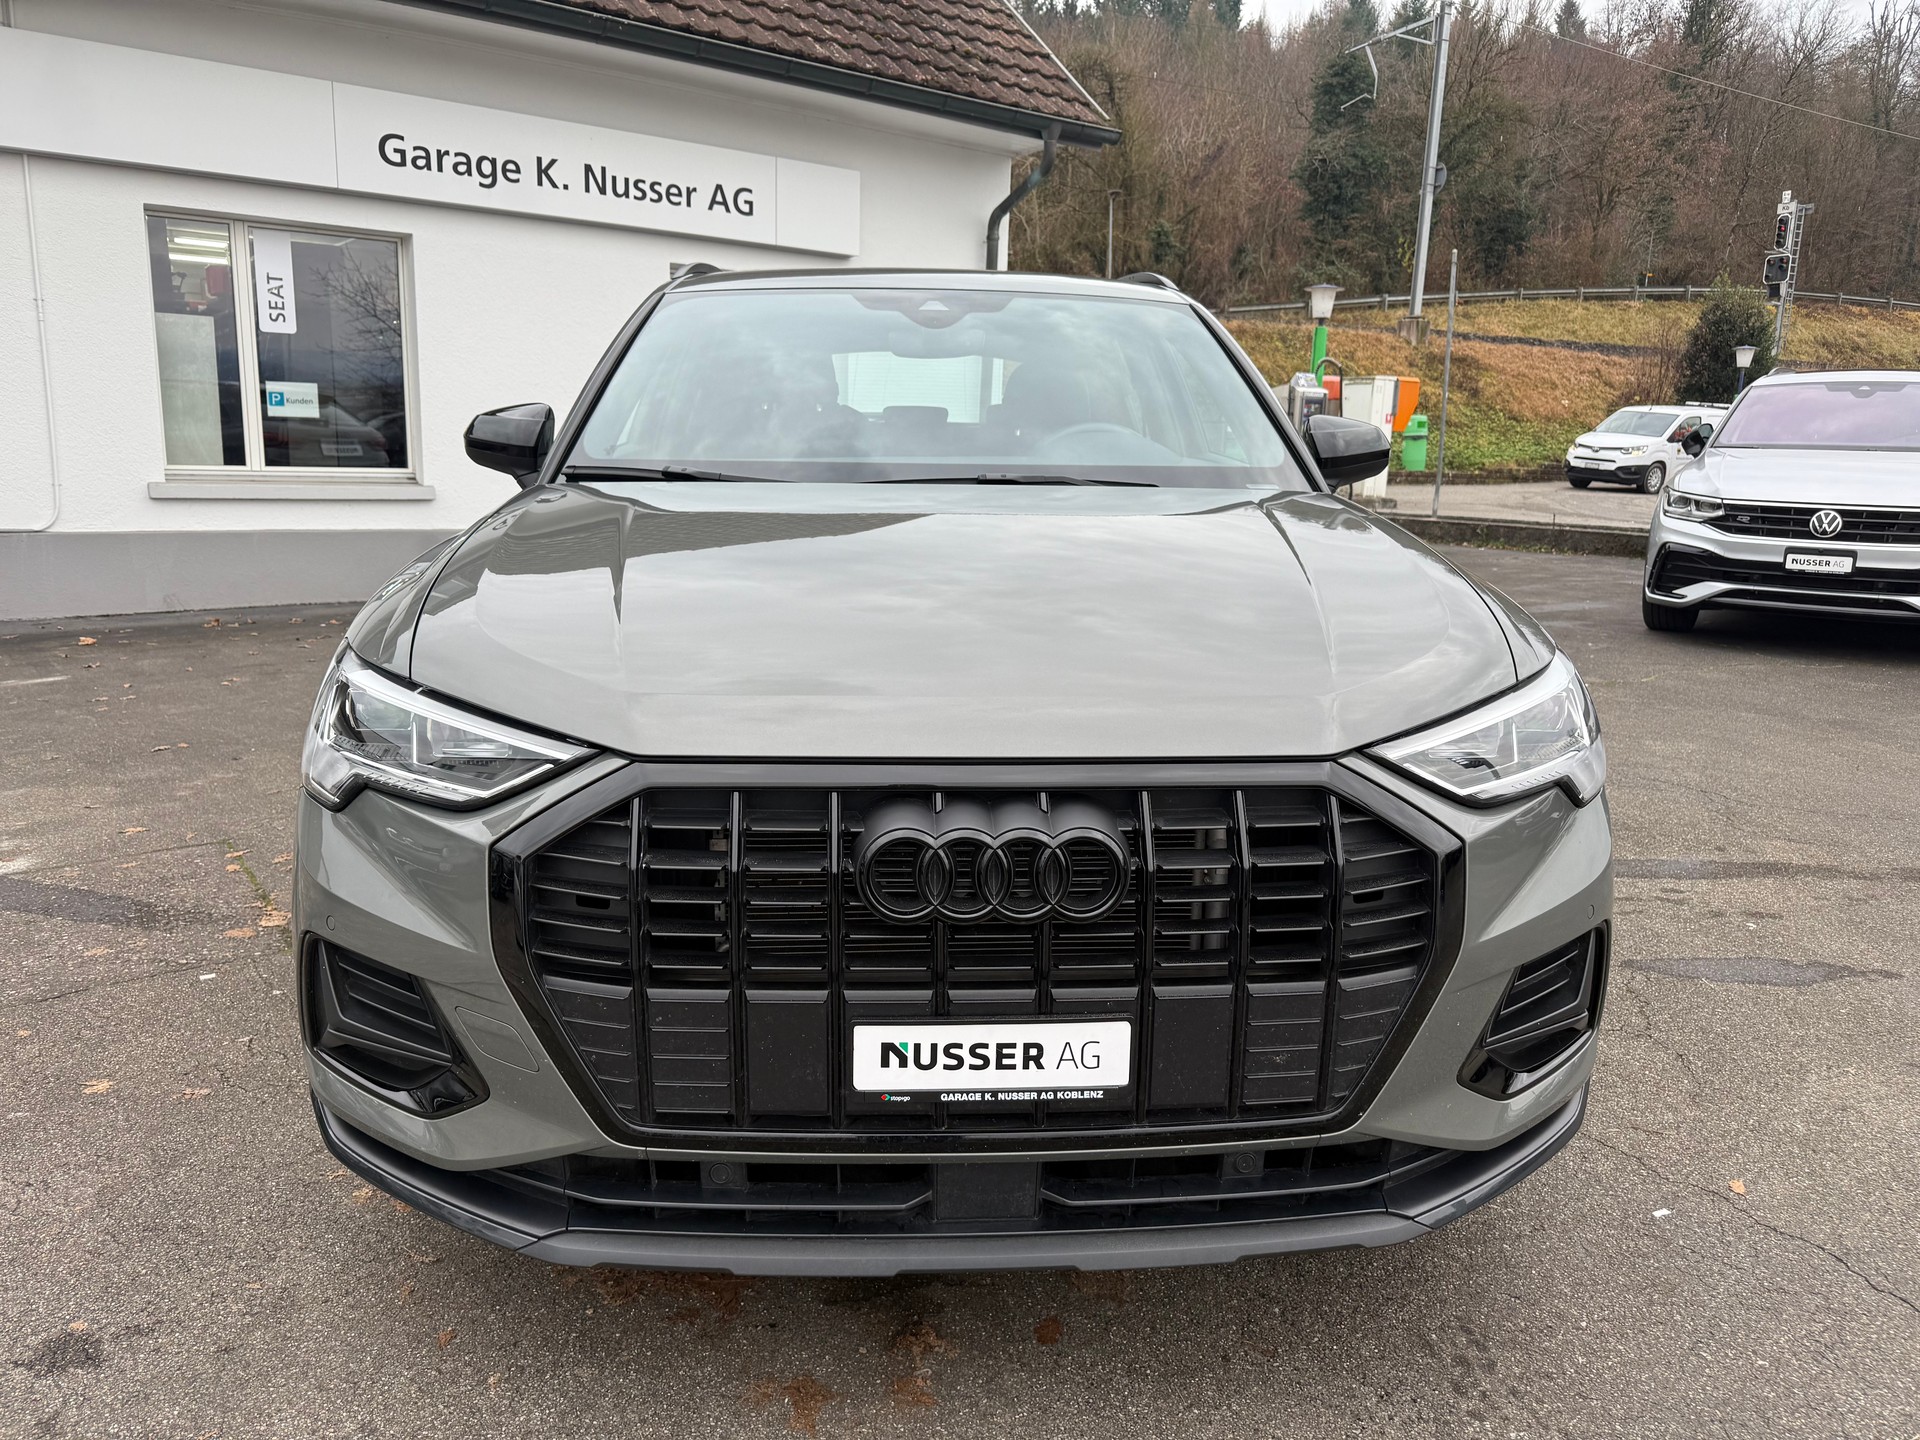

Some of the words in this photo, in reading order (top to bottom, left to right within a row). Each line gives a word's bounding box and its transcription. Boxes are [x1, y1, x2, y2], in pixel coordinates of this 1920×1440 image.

[377, 132, 522, 190] Garage
[535, 156, 570, 191] K.
[583, 163, 698, 208] Nusser
[707, 183, 755, 217] AG
[266, 272, 286, 323] SEAT
[285, 396, 314, 405] Kunden
[1791, 558, 1831, 567] NUSSER
[1832, 560, 1845, 568] AG
[880, 1041, 1045, 1071] NUSSER
[1055, 1040, 1101, 1070] AG
[940, 1092, 982, 1101] GARAGE
[984, 1092, 995, 1101] K.
[998, 1091, 1038, 1101] NUSSER
[1040, 1091, 1055, 1100] AG
[1057, 1090, 1104, 1099] KOBLENZ
